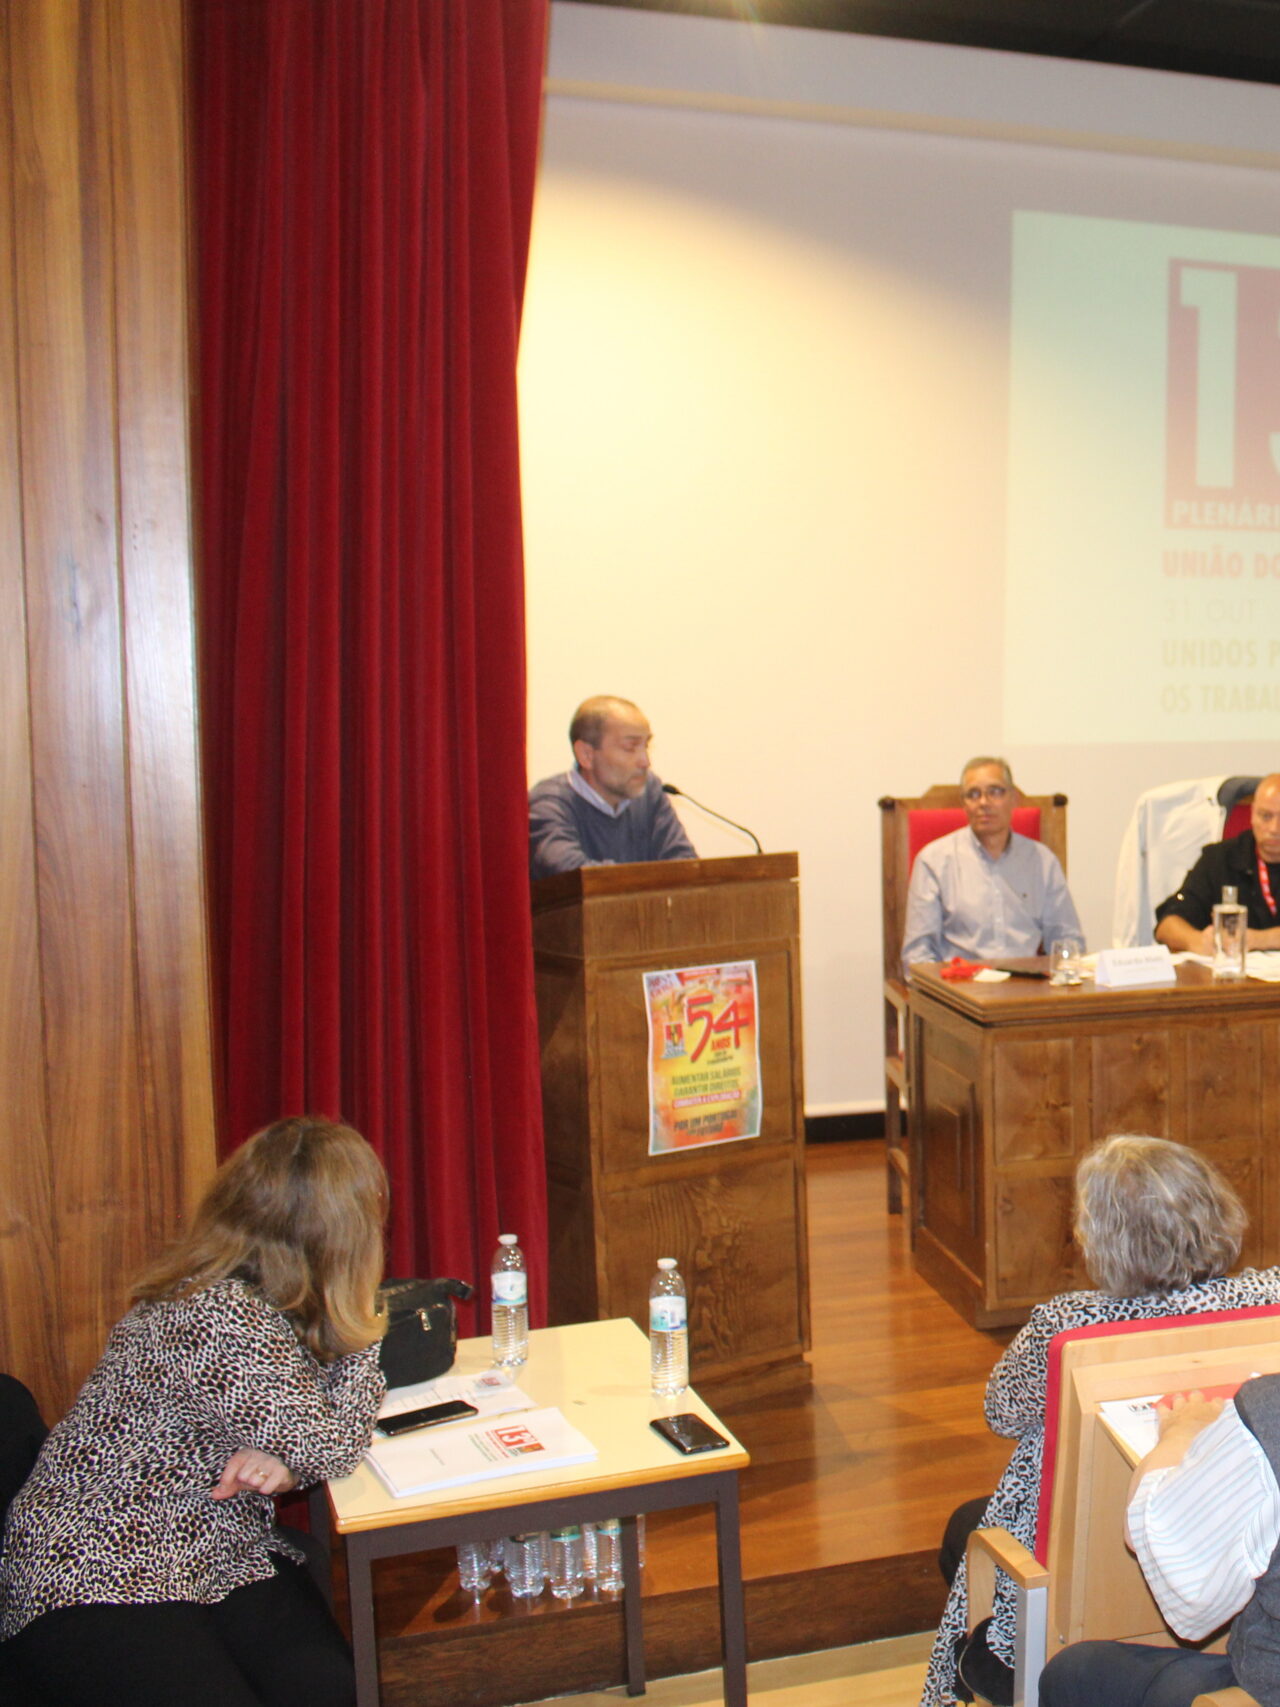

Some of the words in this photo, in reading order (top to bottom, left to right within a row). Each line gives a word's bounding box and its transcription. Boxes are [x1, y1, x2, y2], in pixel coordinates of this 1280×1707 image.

[1162, 544, 1244, 579] UNIÃO
[1161, 639, 1258, 668] UNIDOS
[1160, 684, 1192, 713] OS
[687, 994, 750, 1063] 54
